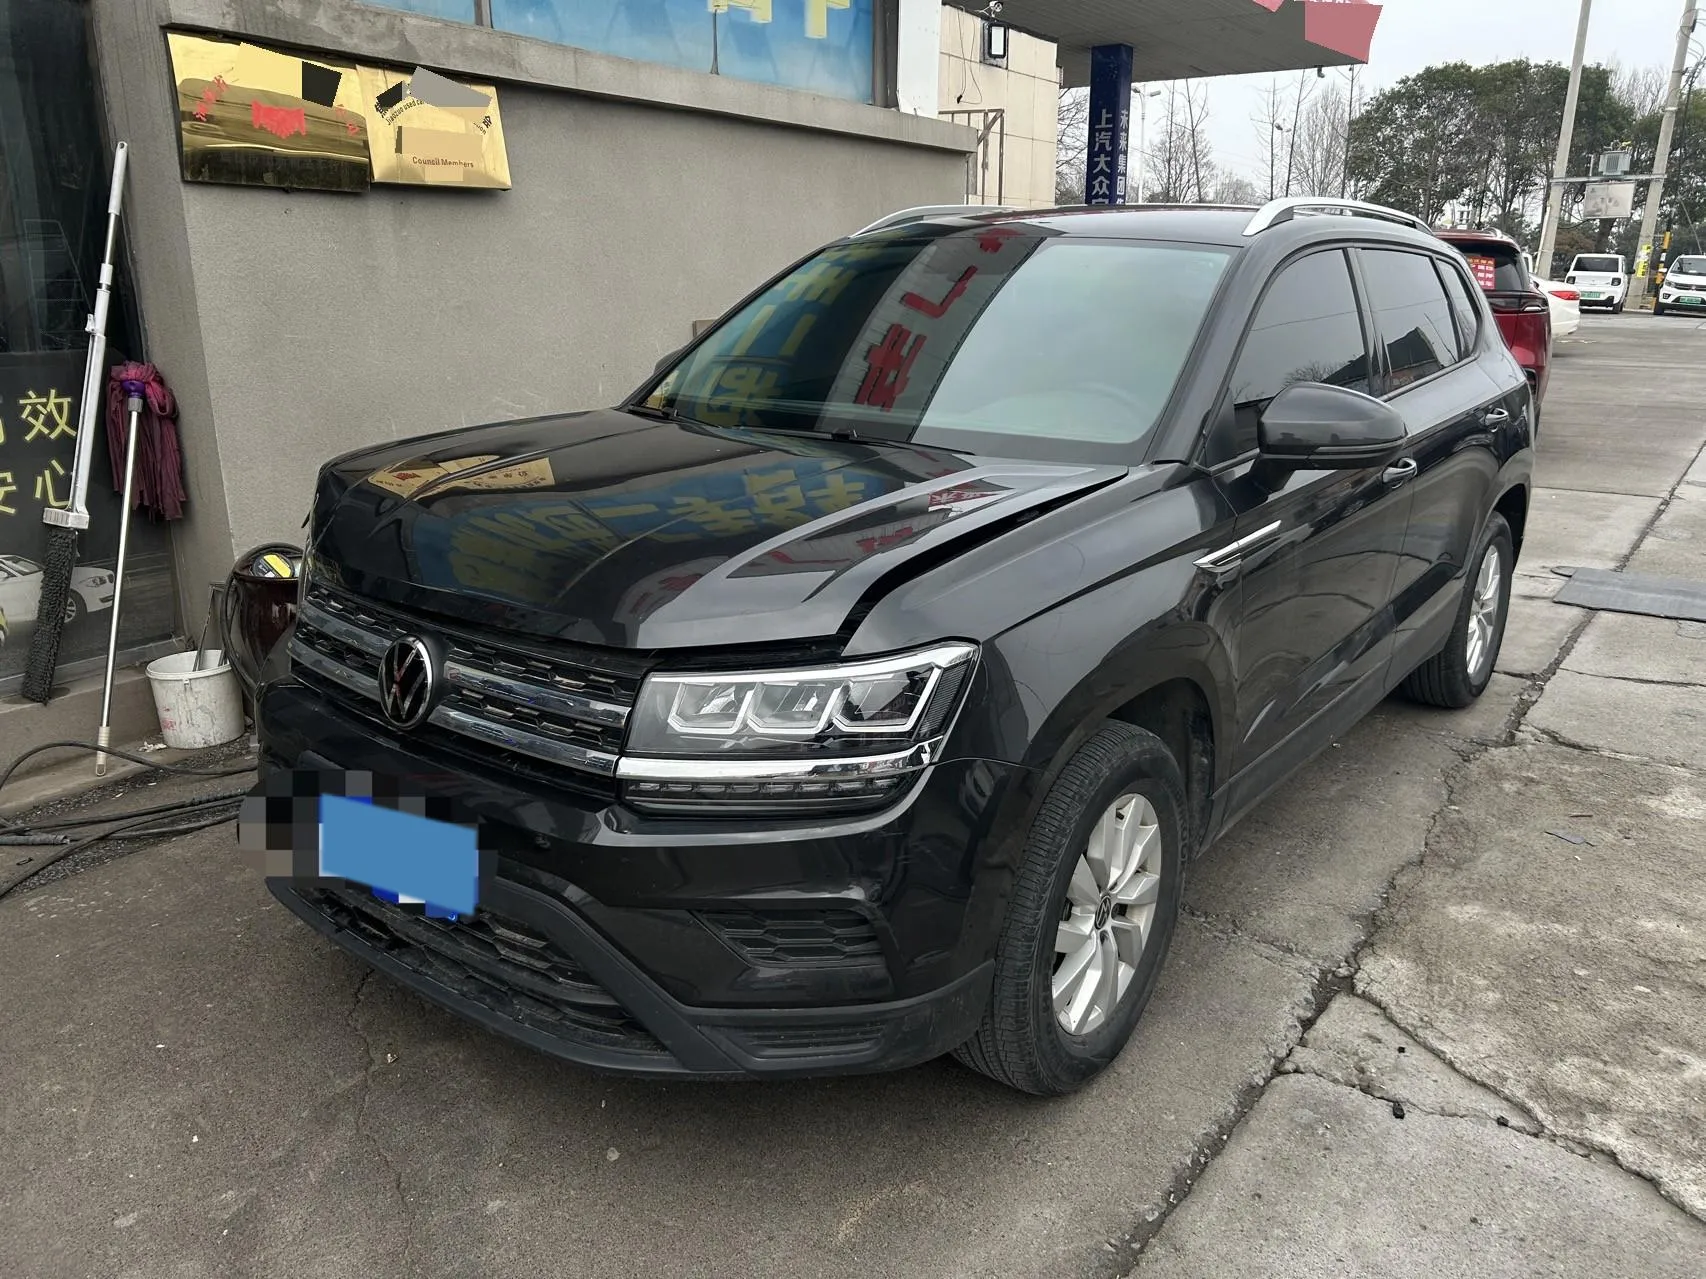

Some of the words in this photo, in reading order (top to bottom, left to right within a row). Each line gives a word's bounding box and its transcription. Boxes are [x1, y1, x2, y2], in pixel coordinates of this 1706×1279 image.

[386, 107, 404, 125] Jiaozuo
[403, 99, 416, 110] used
[412, 156, 440, 167] Council
[440, 158, 474, 168] Members
[0, 389, 78, 444] 效
